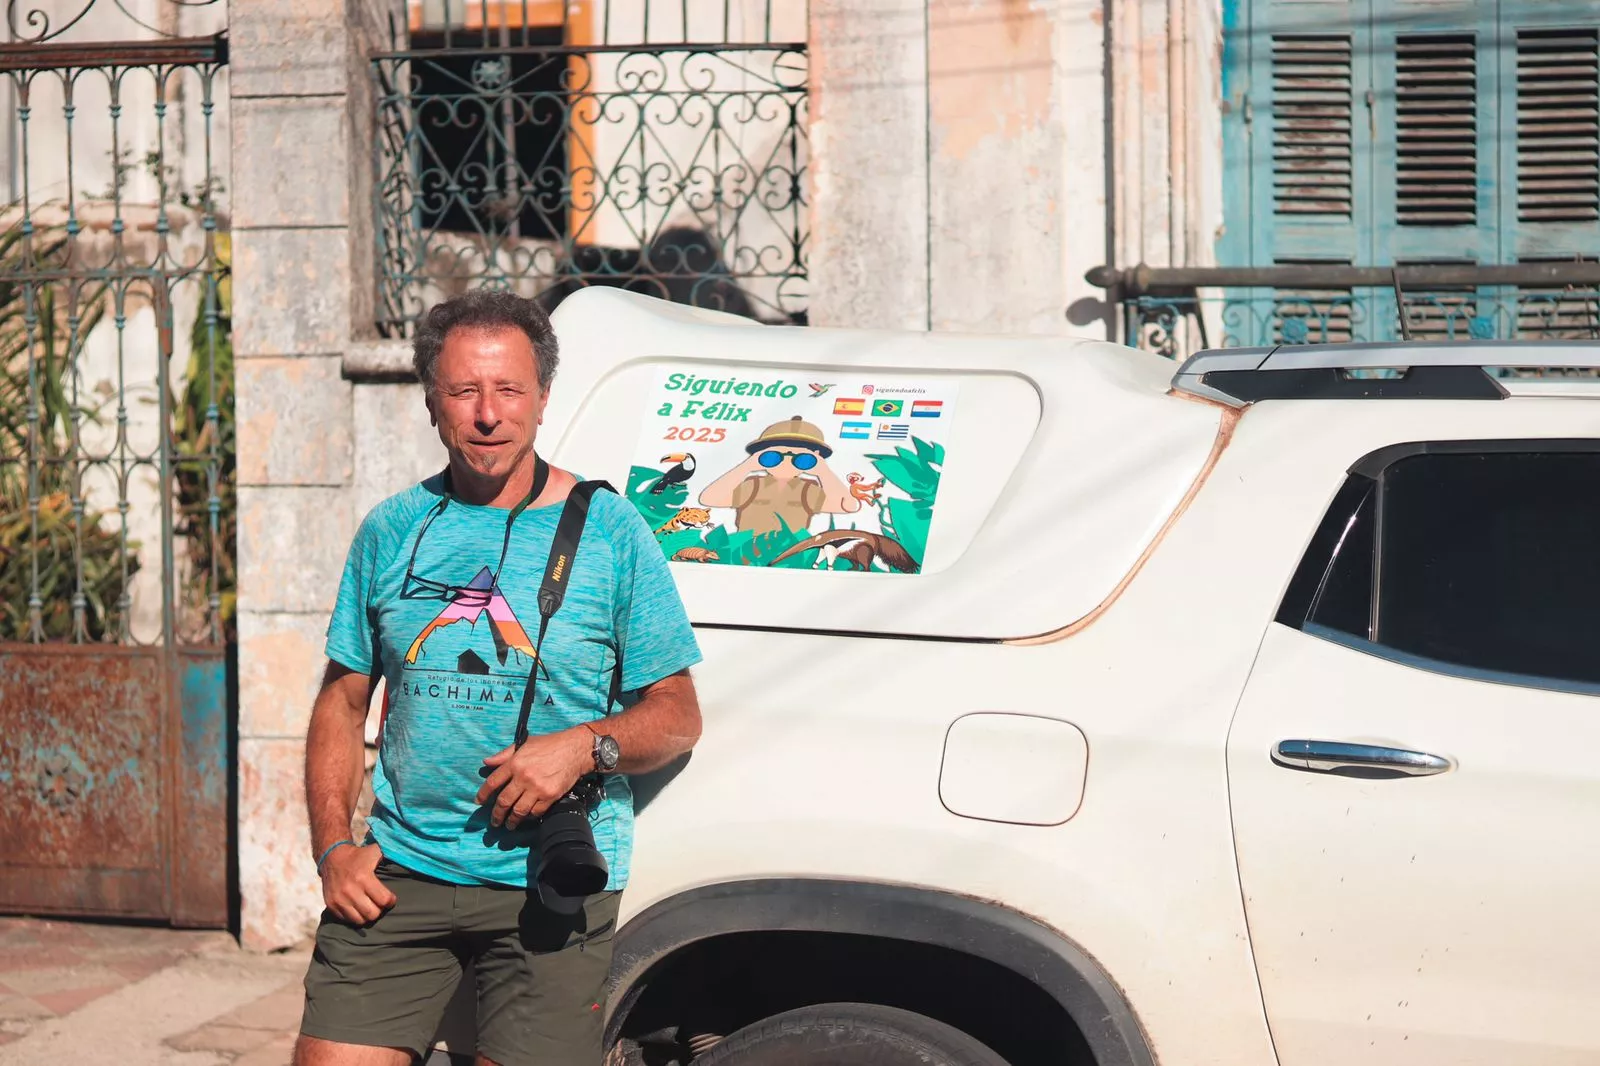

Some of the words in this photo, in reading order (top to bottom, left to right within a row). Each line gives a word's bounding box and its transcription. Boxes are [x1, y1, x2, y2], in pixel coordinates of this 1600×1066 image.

[664, 373, 798, 399] Siguiendo
[656, 402, 673, 417] a
[680, 400, 753, 422] Félix
[663, 426, 727, 443] 2025
[552, 554, 567, 582] Nikon
[402, 682, 555, 706] BACHIMAA
